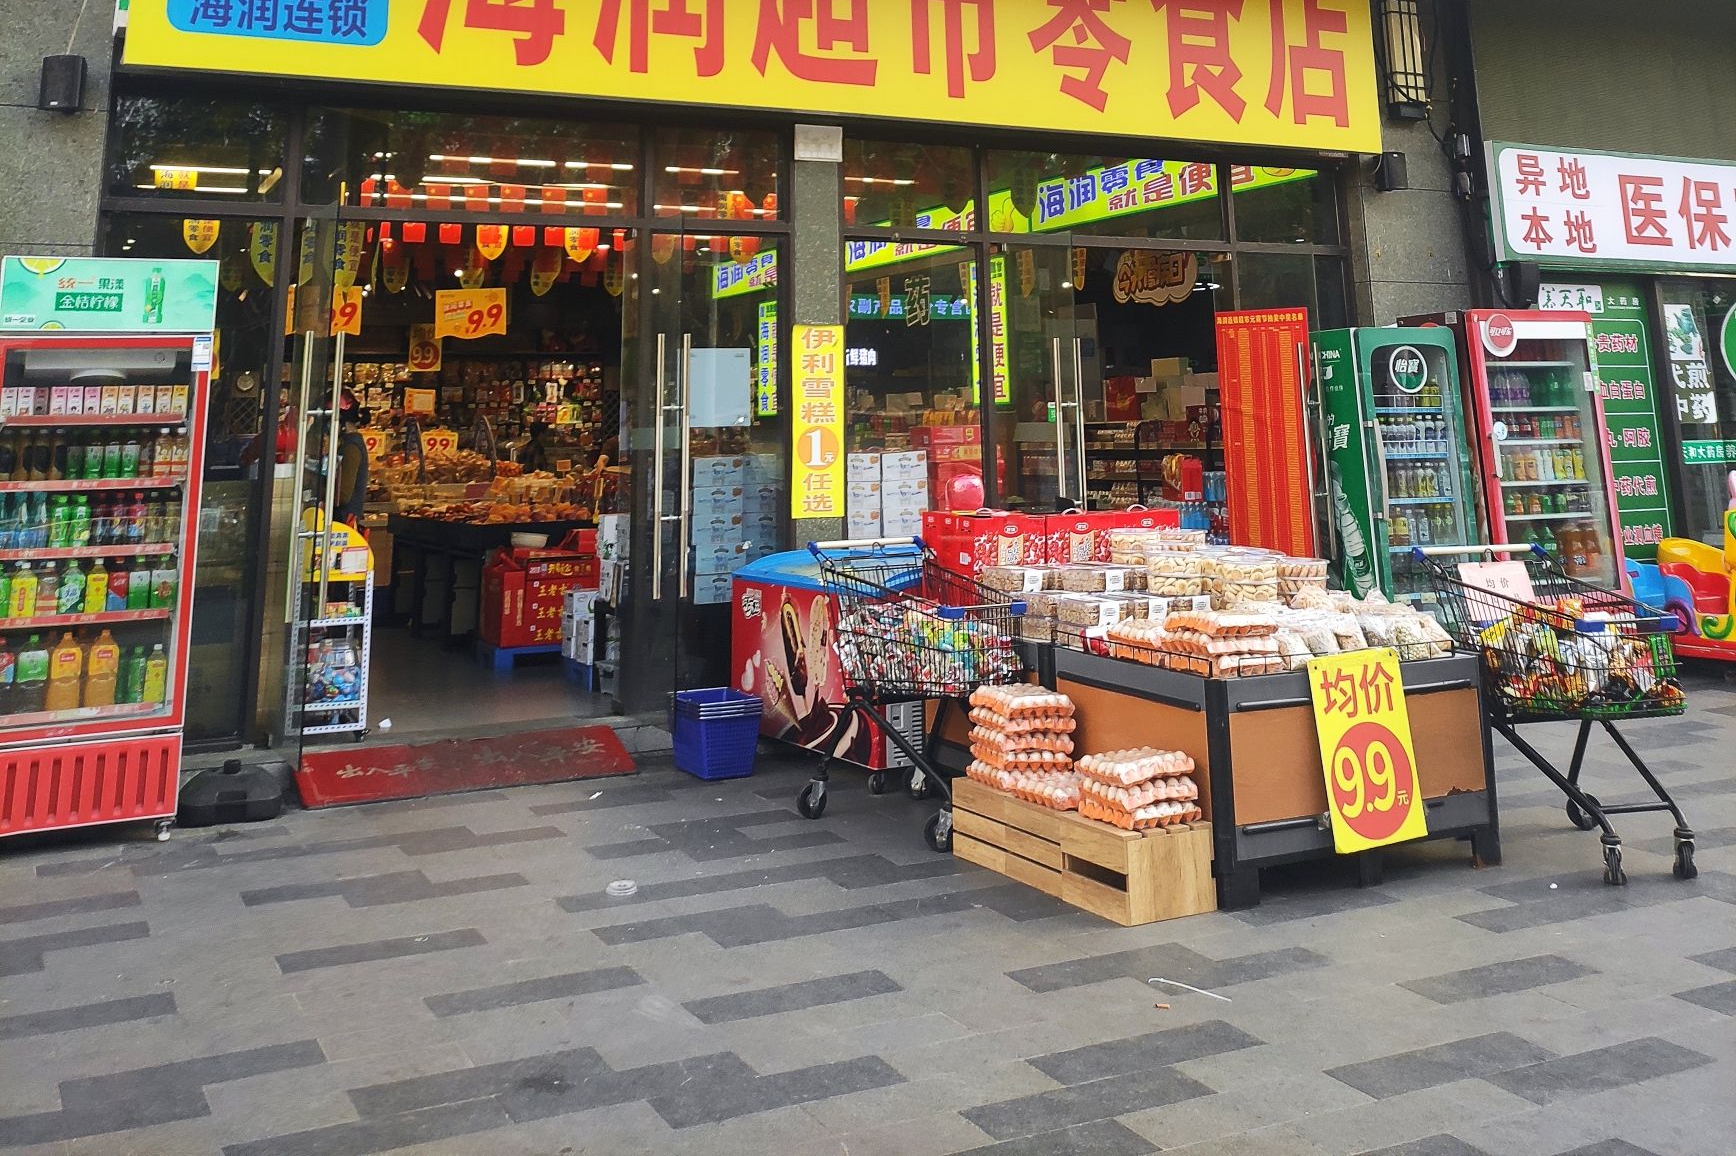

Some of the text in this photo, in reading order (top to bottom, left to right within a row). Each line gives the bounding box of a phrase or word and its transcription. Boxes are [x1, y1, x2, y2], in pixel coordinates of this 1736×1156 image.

[1038, 159, 1164, 223] 海润零食
[1515, 154, 1736, 252] 异地 医保
[1520, 205, 1598, 254] 本地
[1594, 332, 1639, 354] 贵药材
[801, 327, 836, 424] 伊利雪糕
[803, 472, 833, 512] 任选
[1320, 661, 1394, 718] 均价
